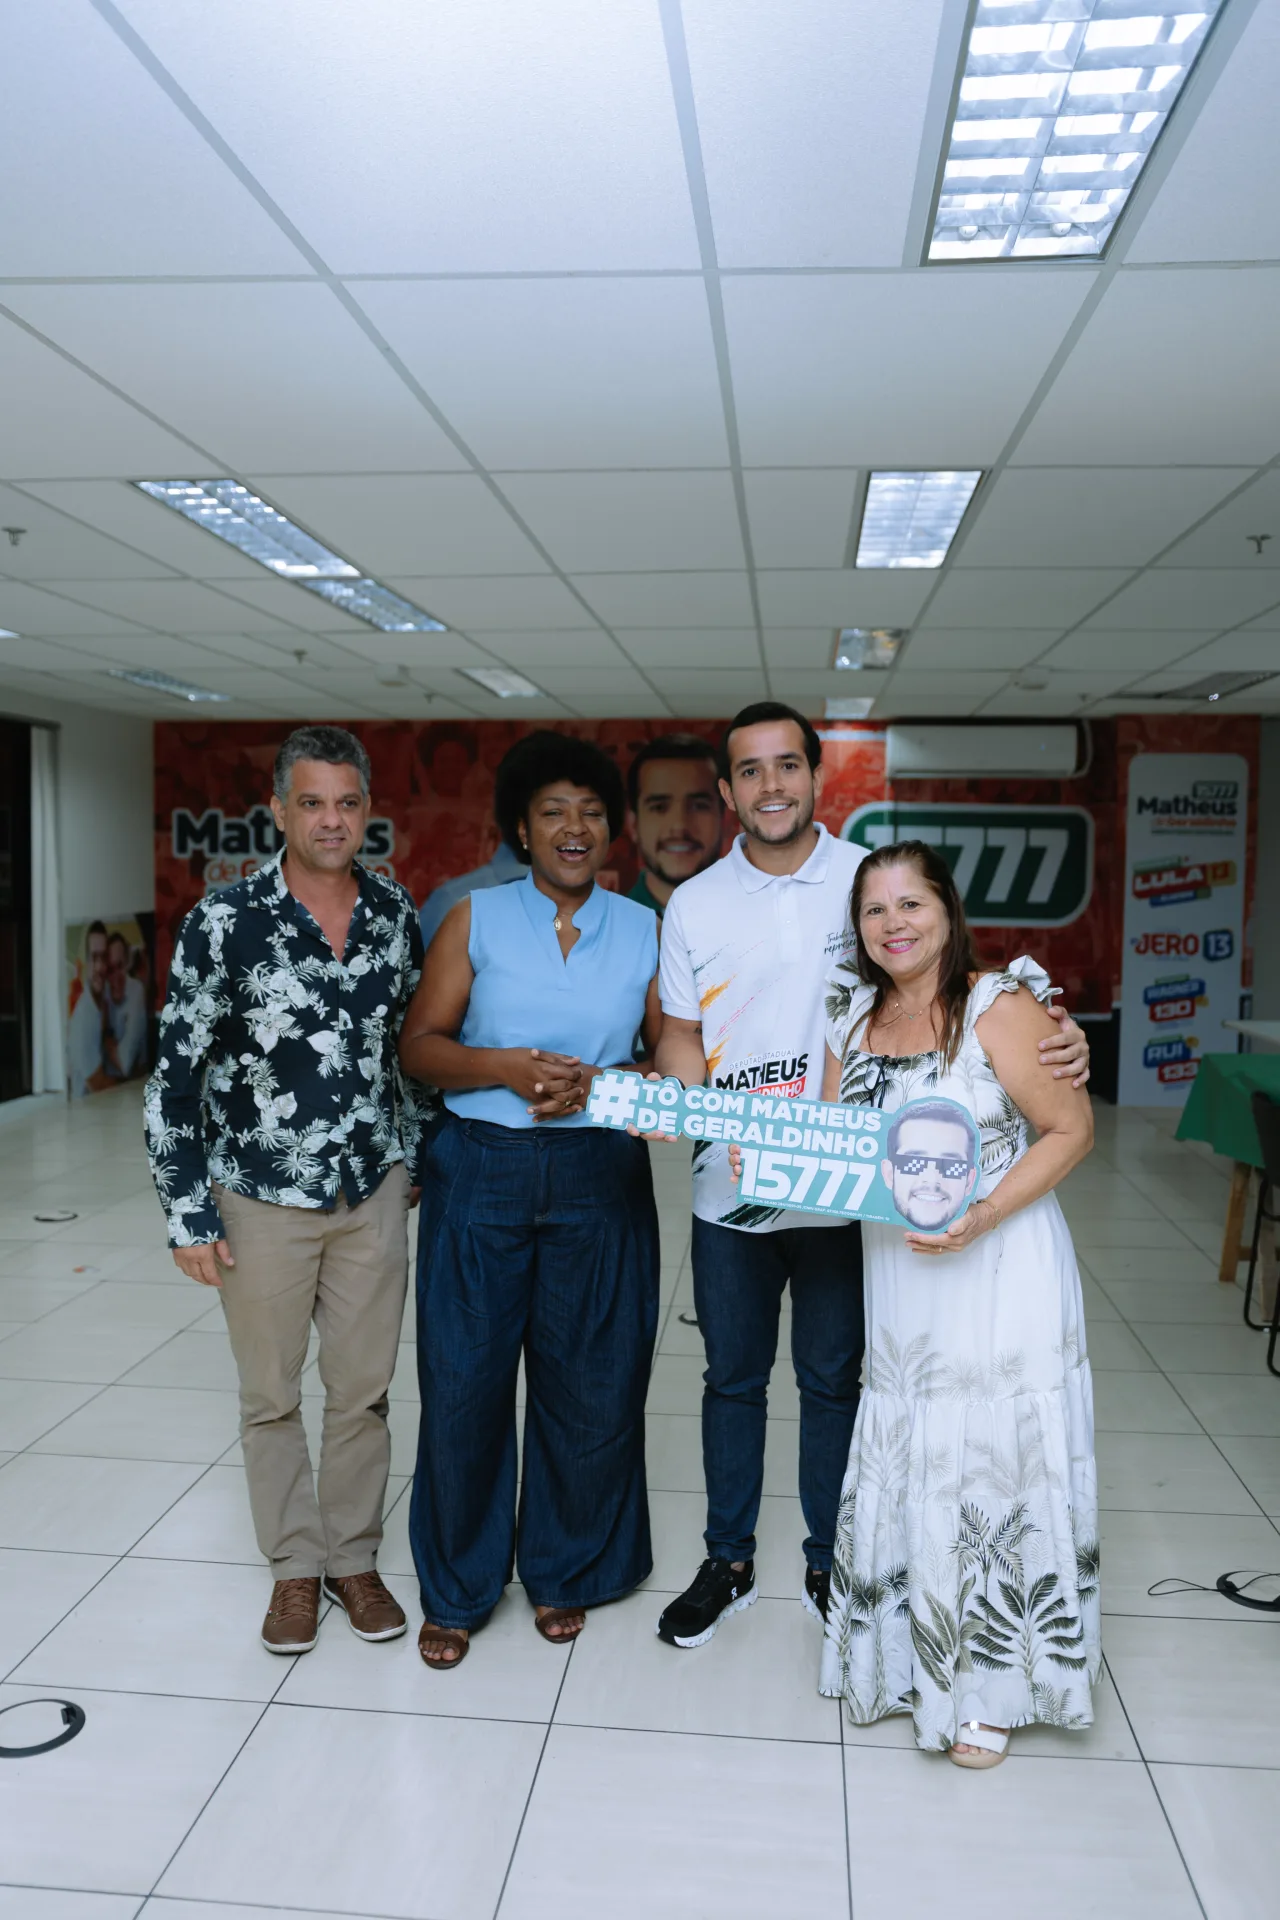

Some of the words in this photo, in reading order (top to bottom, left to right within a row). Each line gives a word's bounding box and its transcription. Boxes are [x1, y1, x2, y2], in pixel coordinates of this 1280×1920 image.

[1137, 795, 1238, 815] Matheus
[1134, 867, 1204, 892] LULA
[1134, 933, 1200, 955] JERO
[1207, 933, 1231, 957] 13
[1147, 1041, 1184, 1060] RUI
[684, 1089, 746, 1115] COM
[751, 1097, 882, 1132] MATHEUS
[636, 1107, 678, 1133] DE
[683, 1114, 879, 1159] GERALDINHO
[739, 1147, 877, 1212] 15777
